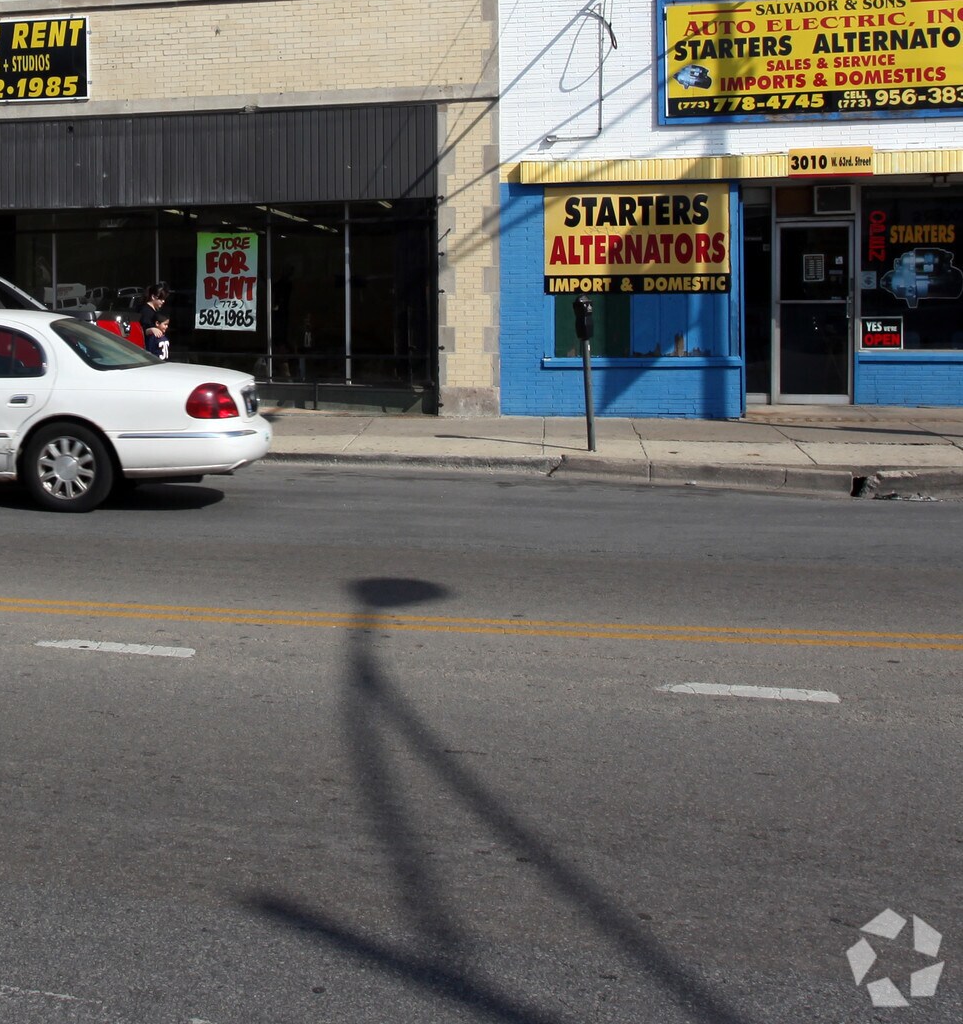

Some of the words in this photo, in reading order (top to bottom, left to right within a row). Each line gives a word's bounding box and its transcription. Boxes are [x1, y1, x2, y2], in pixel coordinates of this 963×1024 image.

[755, 0, 841, 16] SALVADOR
[844, 0, 858, 11] &
[684, 18, 756, 37] AUTO
[766, 12, 916, 33] ELECTRIC,
[11, 19, 84, 50] RENT
[674, 34, 793, 62] STARTERS
[12, 54, 51, 73] STUDIOS
[766, 58, 811, 72] SALES
[816, 57, 829, 70] &
[833, 54, 896, 69] SERVICE
[720, 74, 807, 92] IMPORTS
[812, 72, 828, 88] &
[835, 66, 947, 86] DOMESTICS
[677, 99, 710, 111] (773)
[713, 93, 825, 112] 778-4745
[838, 98, 872, 109] (773)
[843, 90, 868, 100] CELL
[790, 154, 828, 170] 3010
[854, 155, 872, 167] Street
[564, 193, 710, 228] STARTERS
[211, 236, 251, 251] STORE
[868, 209, 886, 262] OPEN
[889, 224, 956, 244] STARTERS
[549, 232, 727, 266] ALTERNATORS
[205, 251, 249, 274] FOR
[203, 276, 257, 301] RENT
[549, 277, 612, 293] IMPORT
[620, 277, 634, 292] &
[643, 275, 727, 292] DOMESTIC
[213, 299, 245, 309] (773)
[865, 321, 883, 332] YES
[864, 333, 901, 346] OPEN
